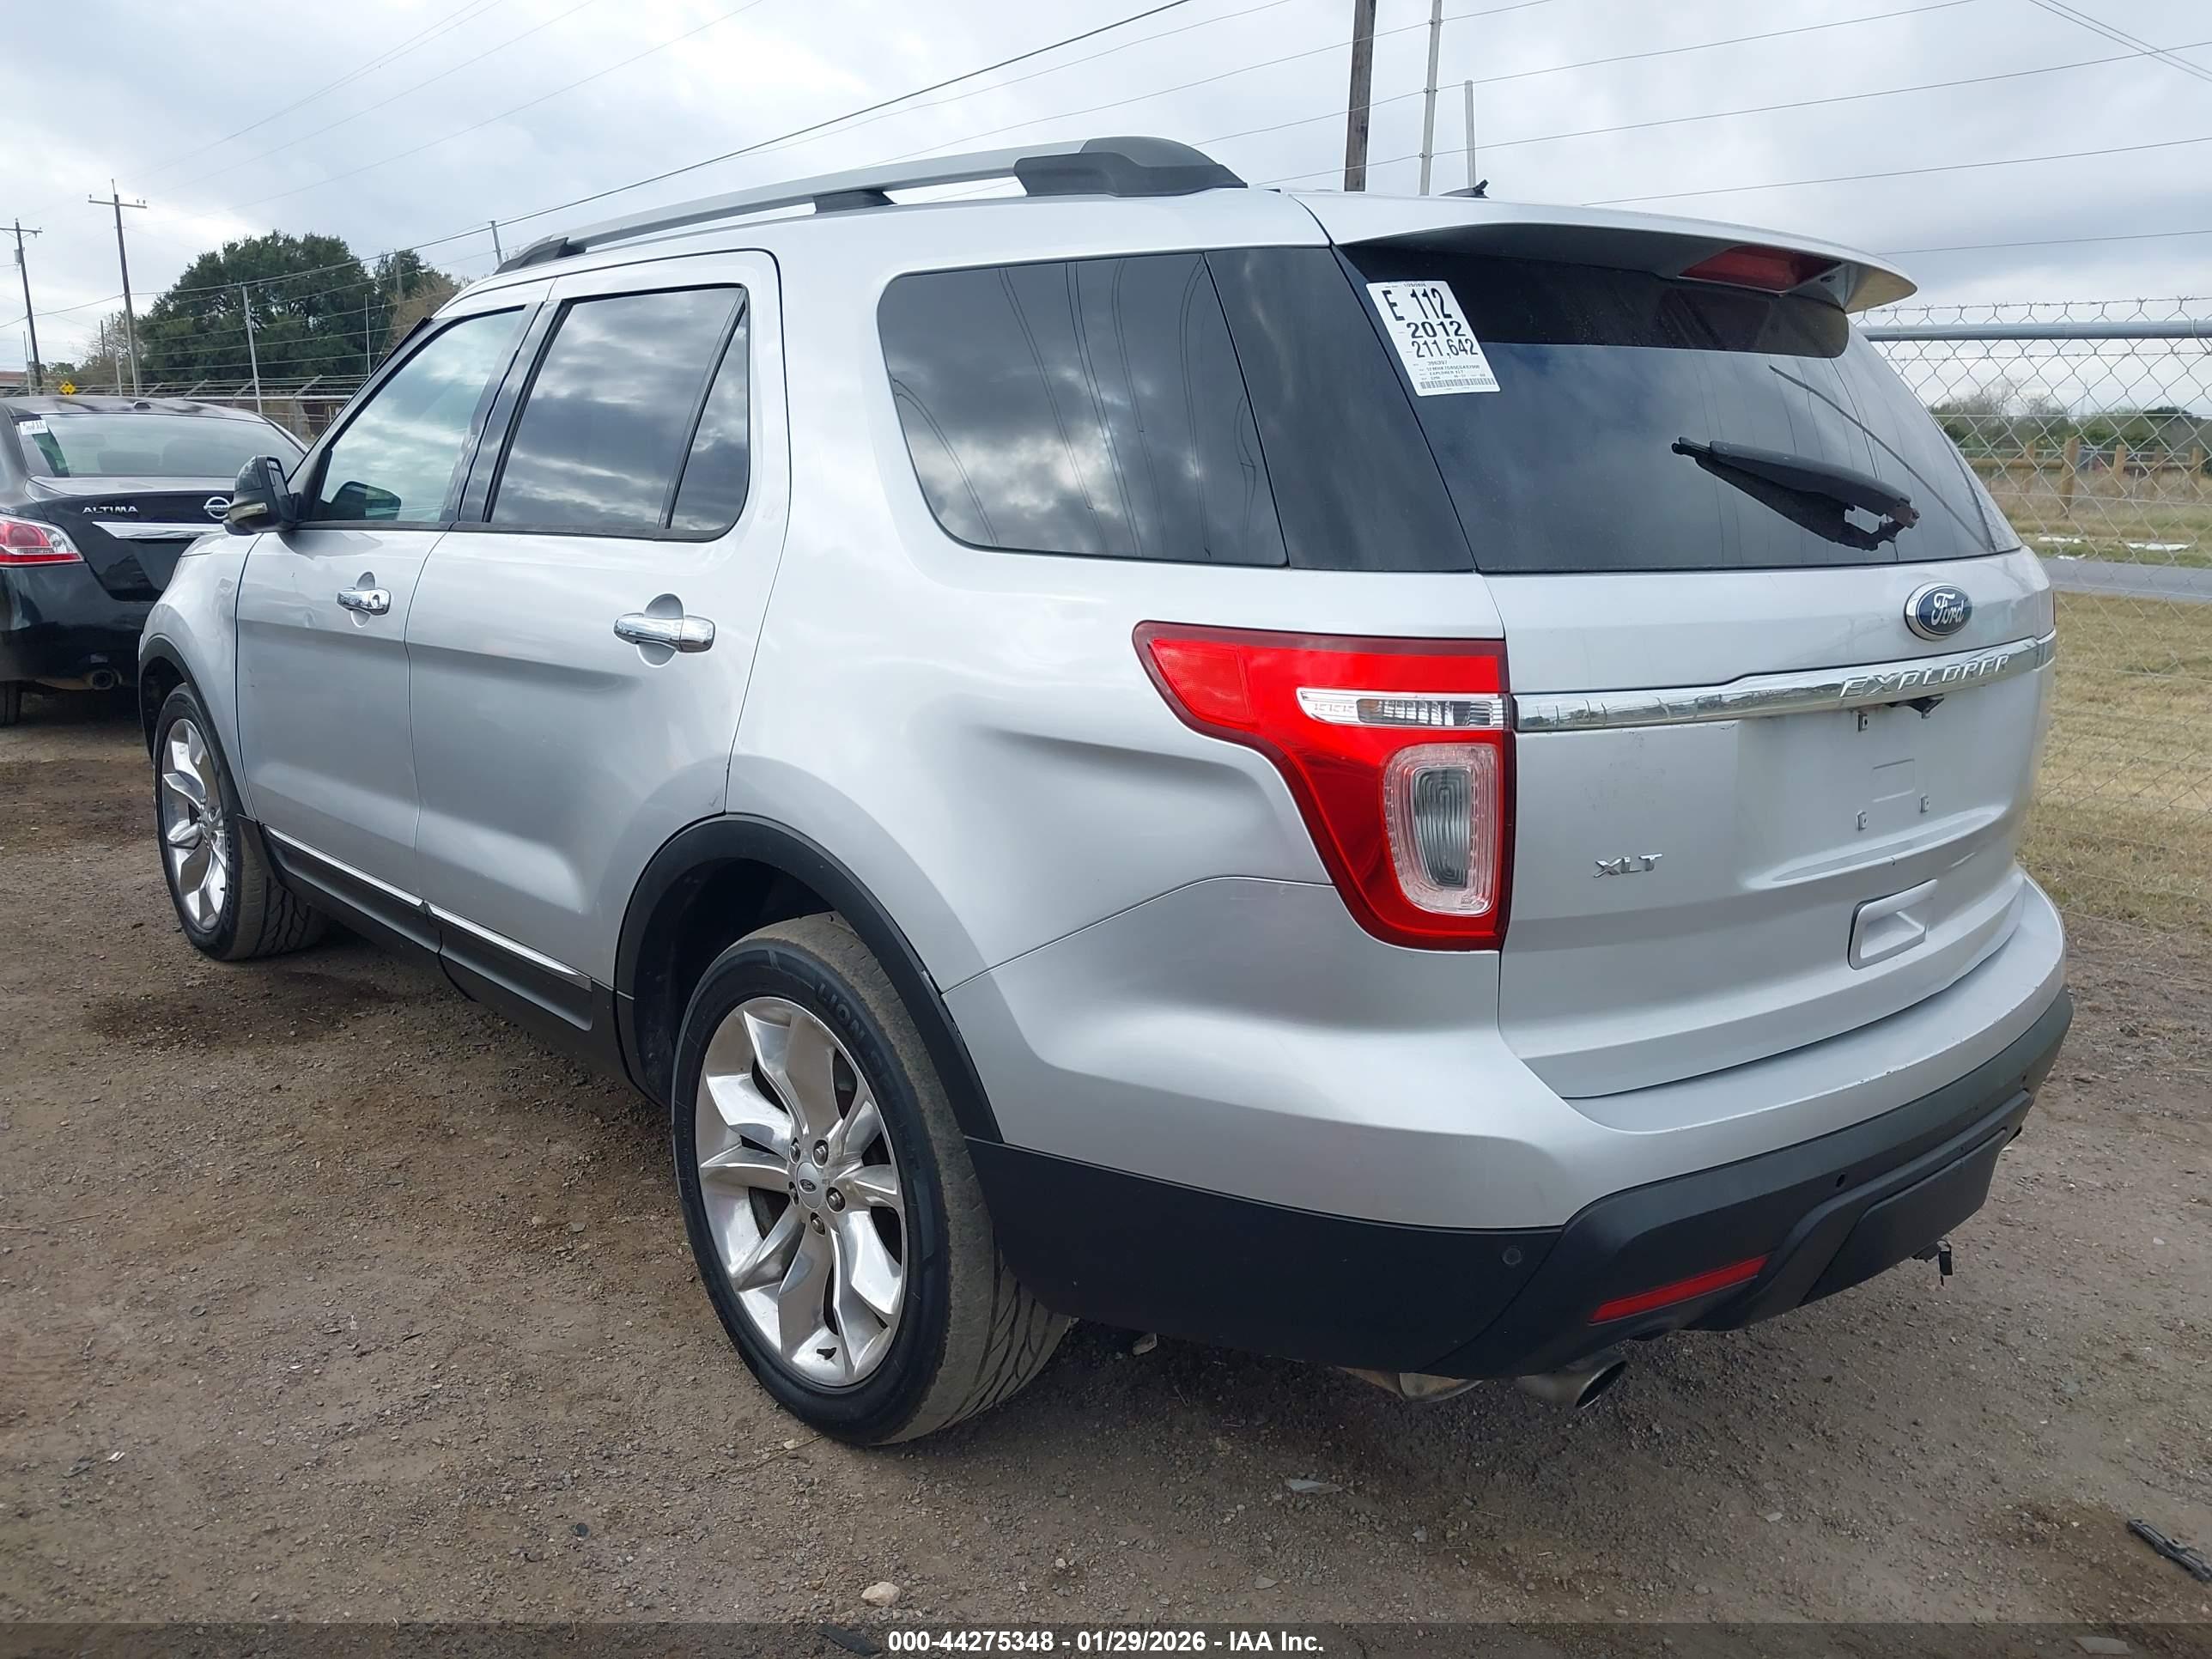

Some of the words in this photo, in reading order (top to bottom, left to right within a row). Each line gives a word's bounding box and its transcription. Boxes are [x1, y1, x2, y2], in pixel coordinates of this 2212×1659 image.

[1382, 289, 1406, 321] E
[1410, 288, 1453, 319] 112
[1407, 320, 1467, 338] 2012
[1411, 338, 1479, 359] 211,642
[1931, 592, 1965, 626] Ford
[1839, 653, 2009, 697] EXPLORER
[1594, 853, 1662, 878] XLT
[817, 981, 866, 1044] LION
